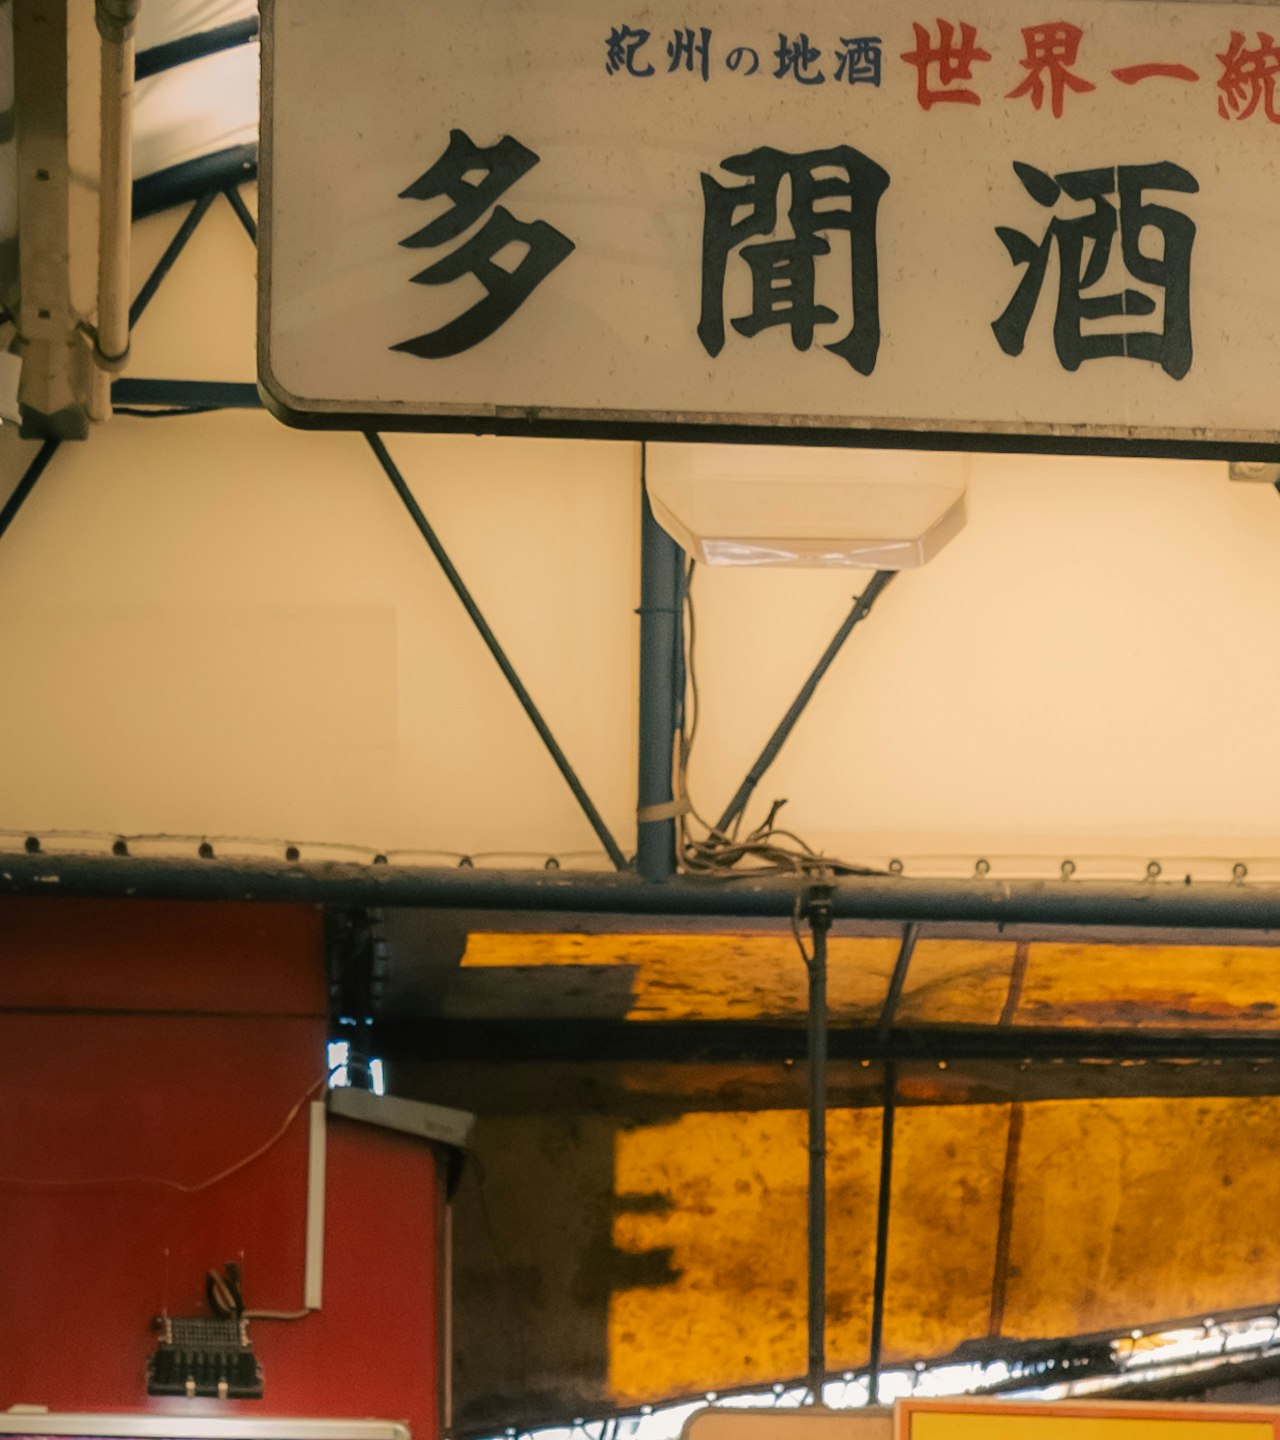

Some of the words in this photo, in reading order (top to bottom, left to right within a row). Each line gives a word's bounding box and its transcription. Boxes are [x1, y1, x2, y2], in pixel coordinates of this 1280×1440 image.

[604, 22, 885, 92] 紀州の地酒
